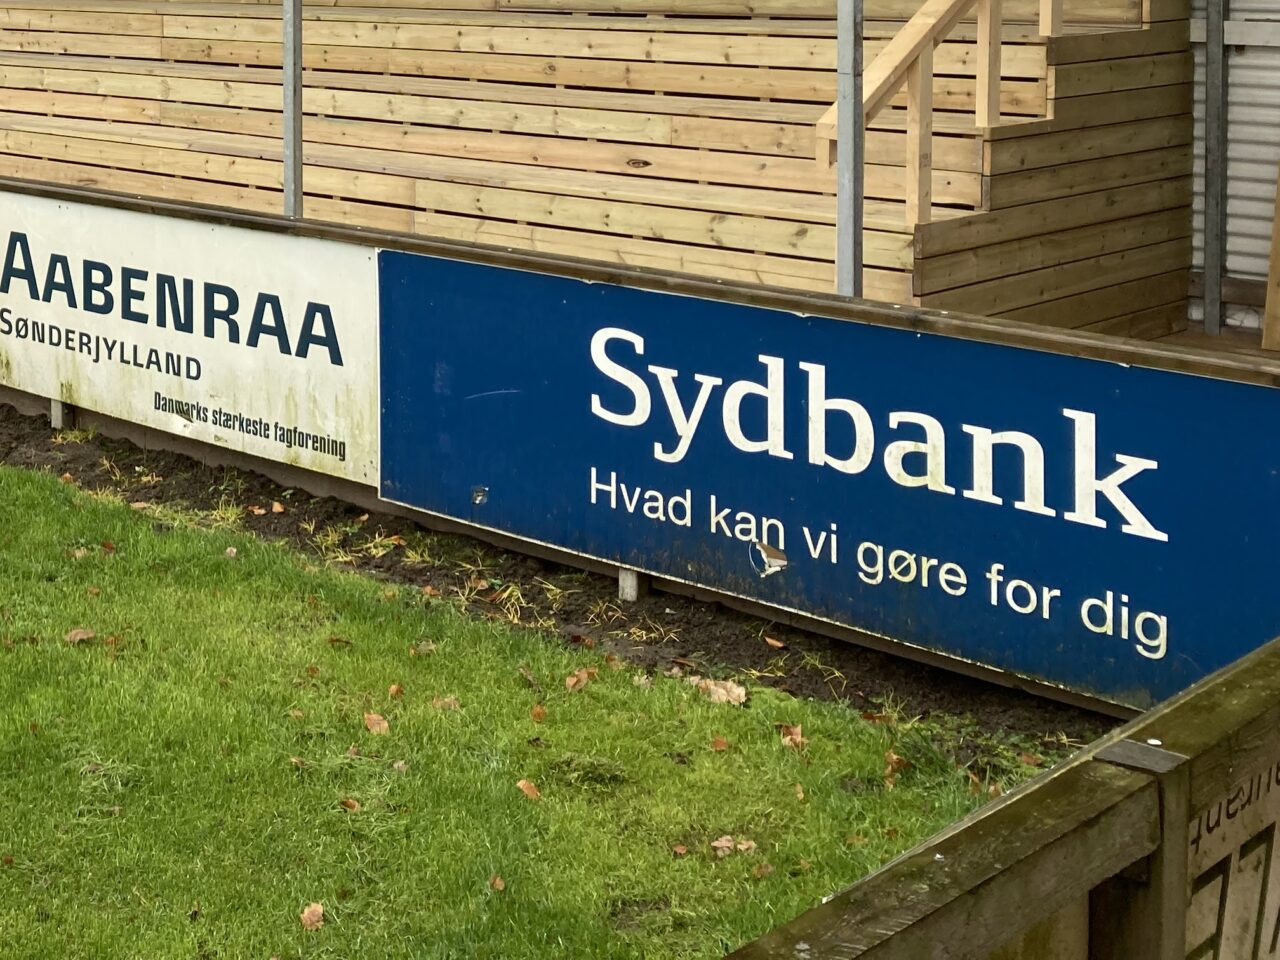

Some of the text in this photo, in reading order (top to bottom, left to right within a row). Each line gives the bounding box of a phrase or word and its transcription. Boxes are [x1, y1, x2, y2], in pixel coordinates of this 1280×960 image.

[154, 391, 346, 461] Danmarks stærkeste fagforening
[589, 326, 1170, 544] Sydbank
[590, 466, 1169, 661] Hvad kan vi gøre for dig
